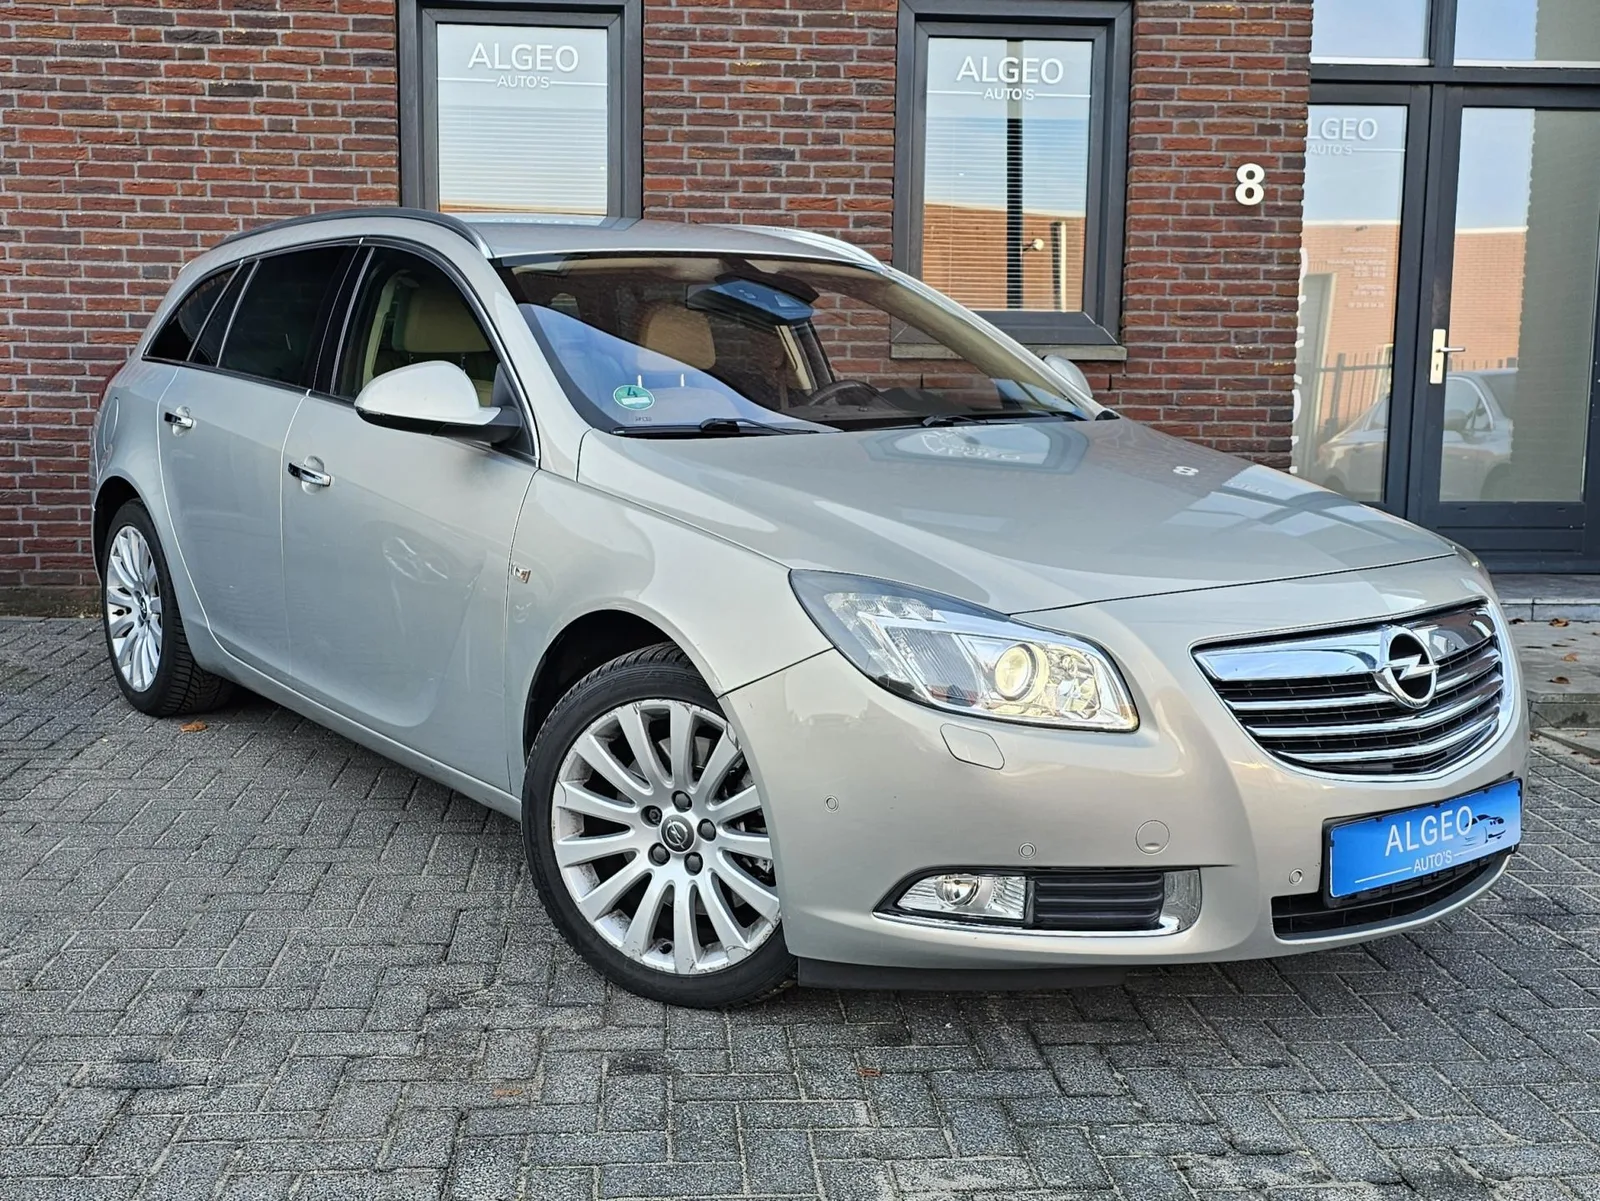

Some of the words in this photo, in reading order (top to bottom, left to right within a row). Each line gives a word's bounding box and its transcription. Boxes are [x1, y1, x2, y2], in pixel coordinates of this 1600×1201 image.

[468, 42, 579, 72] ALGEO
[956, 55, 1064, 84] ALGEO
[497, 75, 550, 88] AUTO'S
[984, 88, 1035, 100] AUTO'S
[1309, 144, 1353, 155] AUTO'S
[1235, 163, 1265, 206] 8
[1385, 805, 1473, 857] ALGEO
[1413, 850, 1453, 873] AUTO'S
